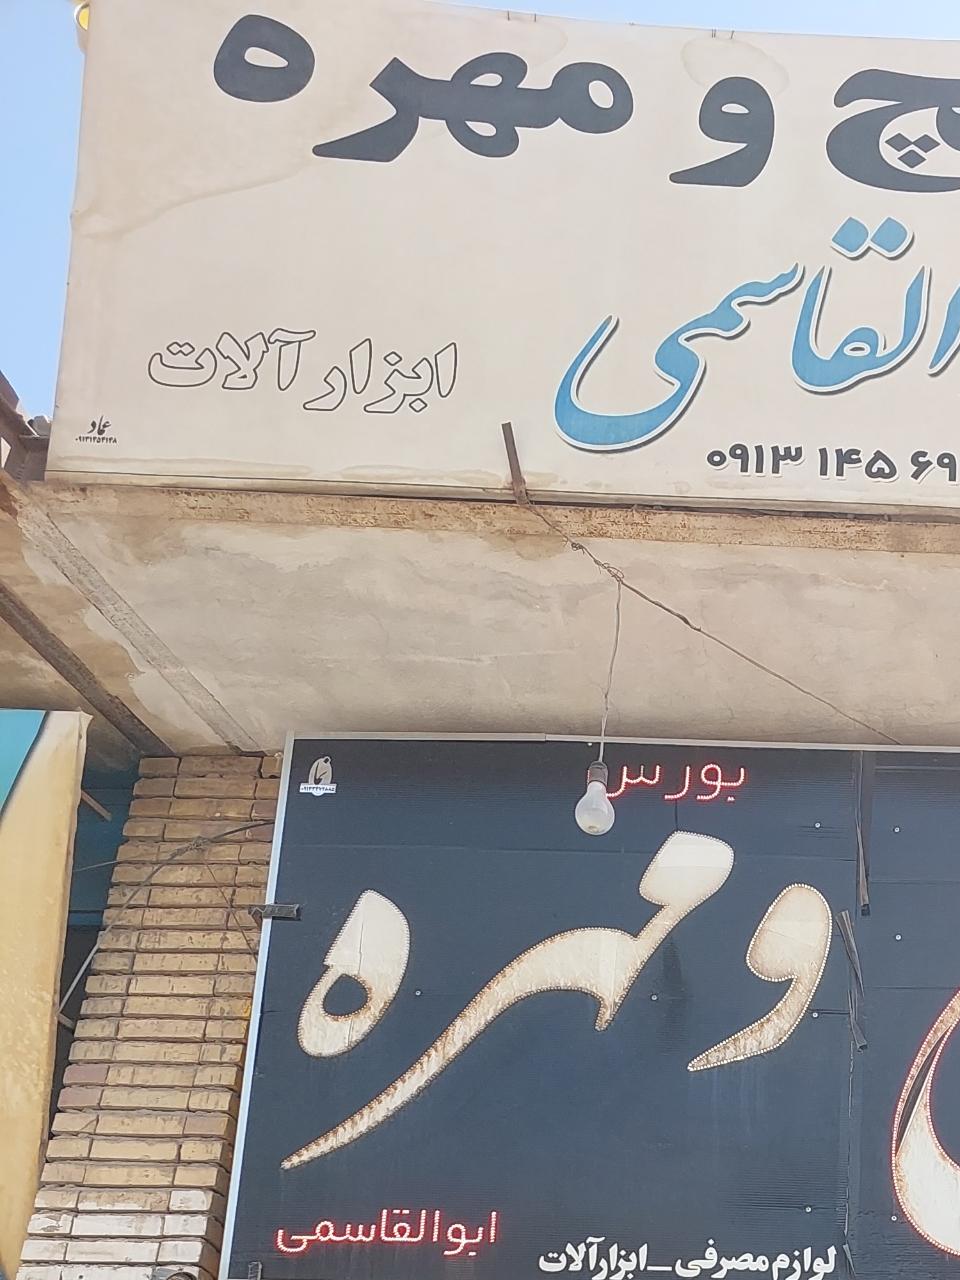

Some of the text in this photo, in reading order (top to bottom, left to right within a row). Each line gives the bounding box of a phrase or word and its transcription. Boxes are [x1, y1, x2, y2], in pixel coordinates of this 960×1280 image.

[213, 14, 634, 162] مهره
[669, 77, 776, 187] و
[587, 763, 746, 802] بورس
[280, 829, 735, 1171] مهره
[687, 883, 833, 1072] و
